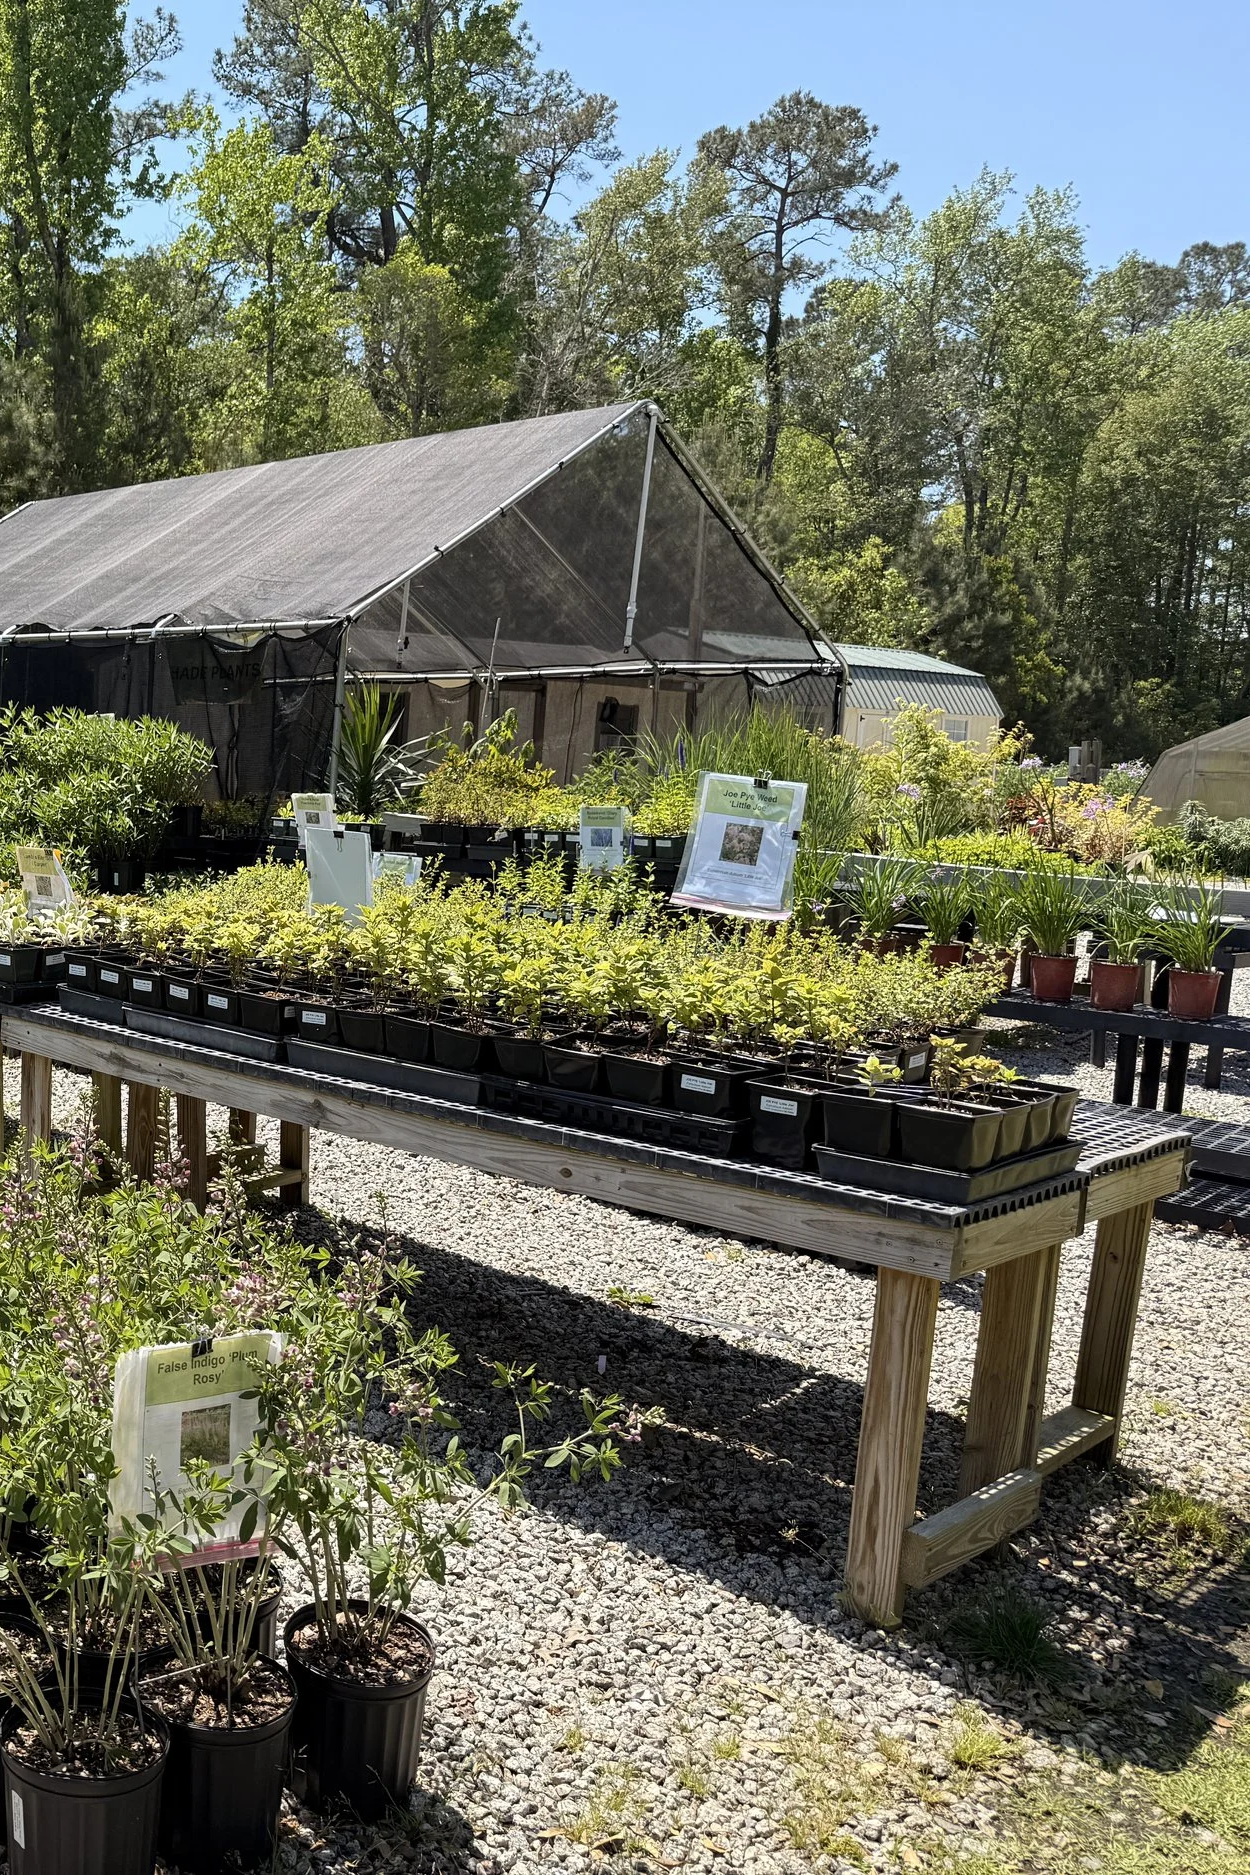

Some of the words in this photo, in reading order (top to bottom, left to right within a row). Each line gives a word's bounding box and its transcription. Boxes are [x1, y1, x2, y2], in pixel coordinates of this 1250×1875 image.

[170, 665, 208, 681] HADE
[211, 663, 261, 681] PLANTS
[723, 789, 738, 798] Joe
[740, 791, 755, 801] Pye
[757, 793, 778, 803] Weed
[157, 1361, 188, 1374] False
[191, 1355, 226, 1369] Indigo
[193, 1369, 225, 1385] Rosy'
